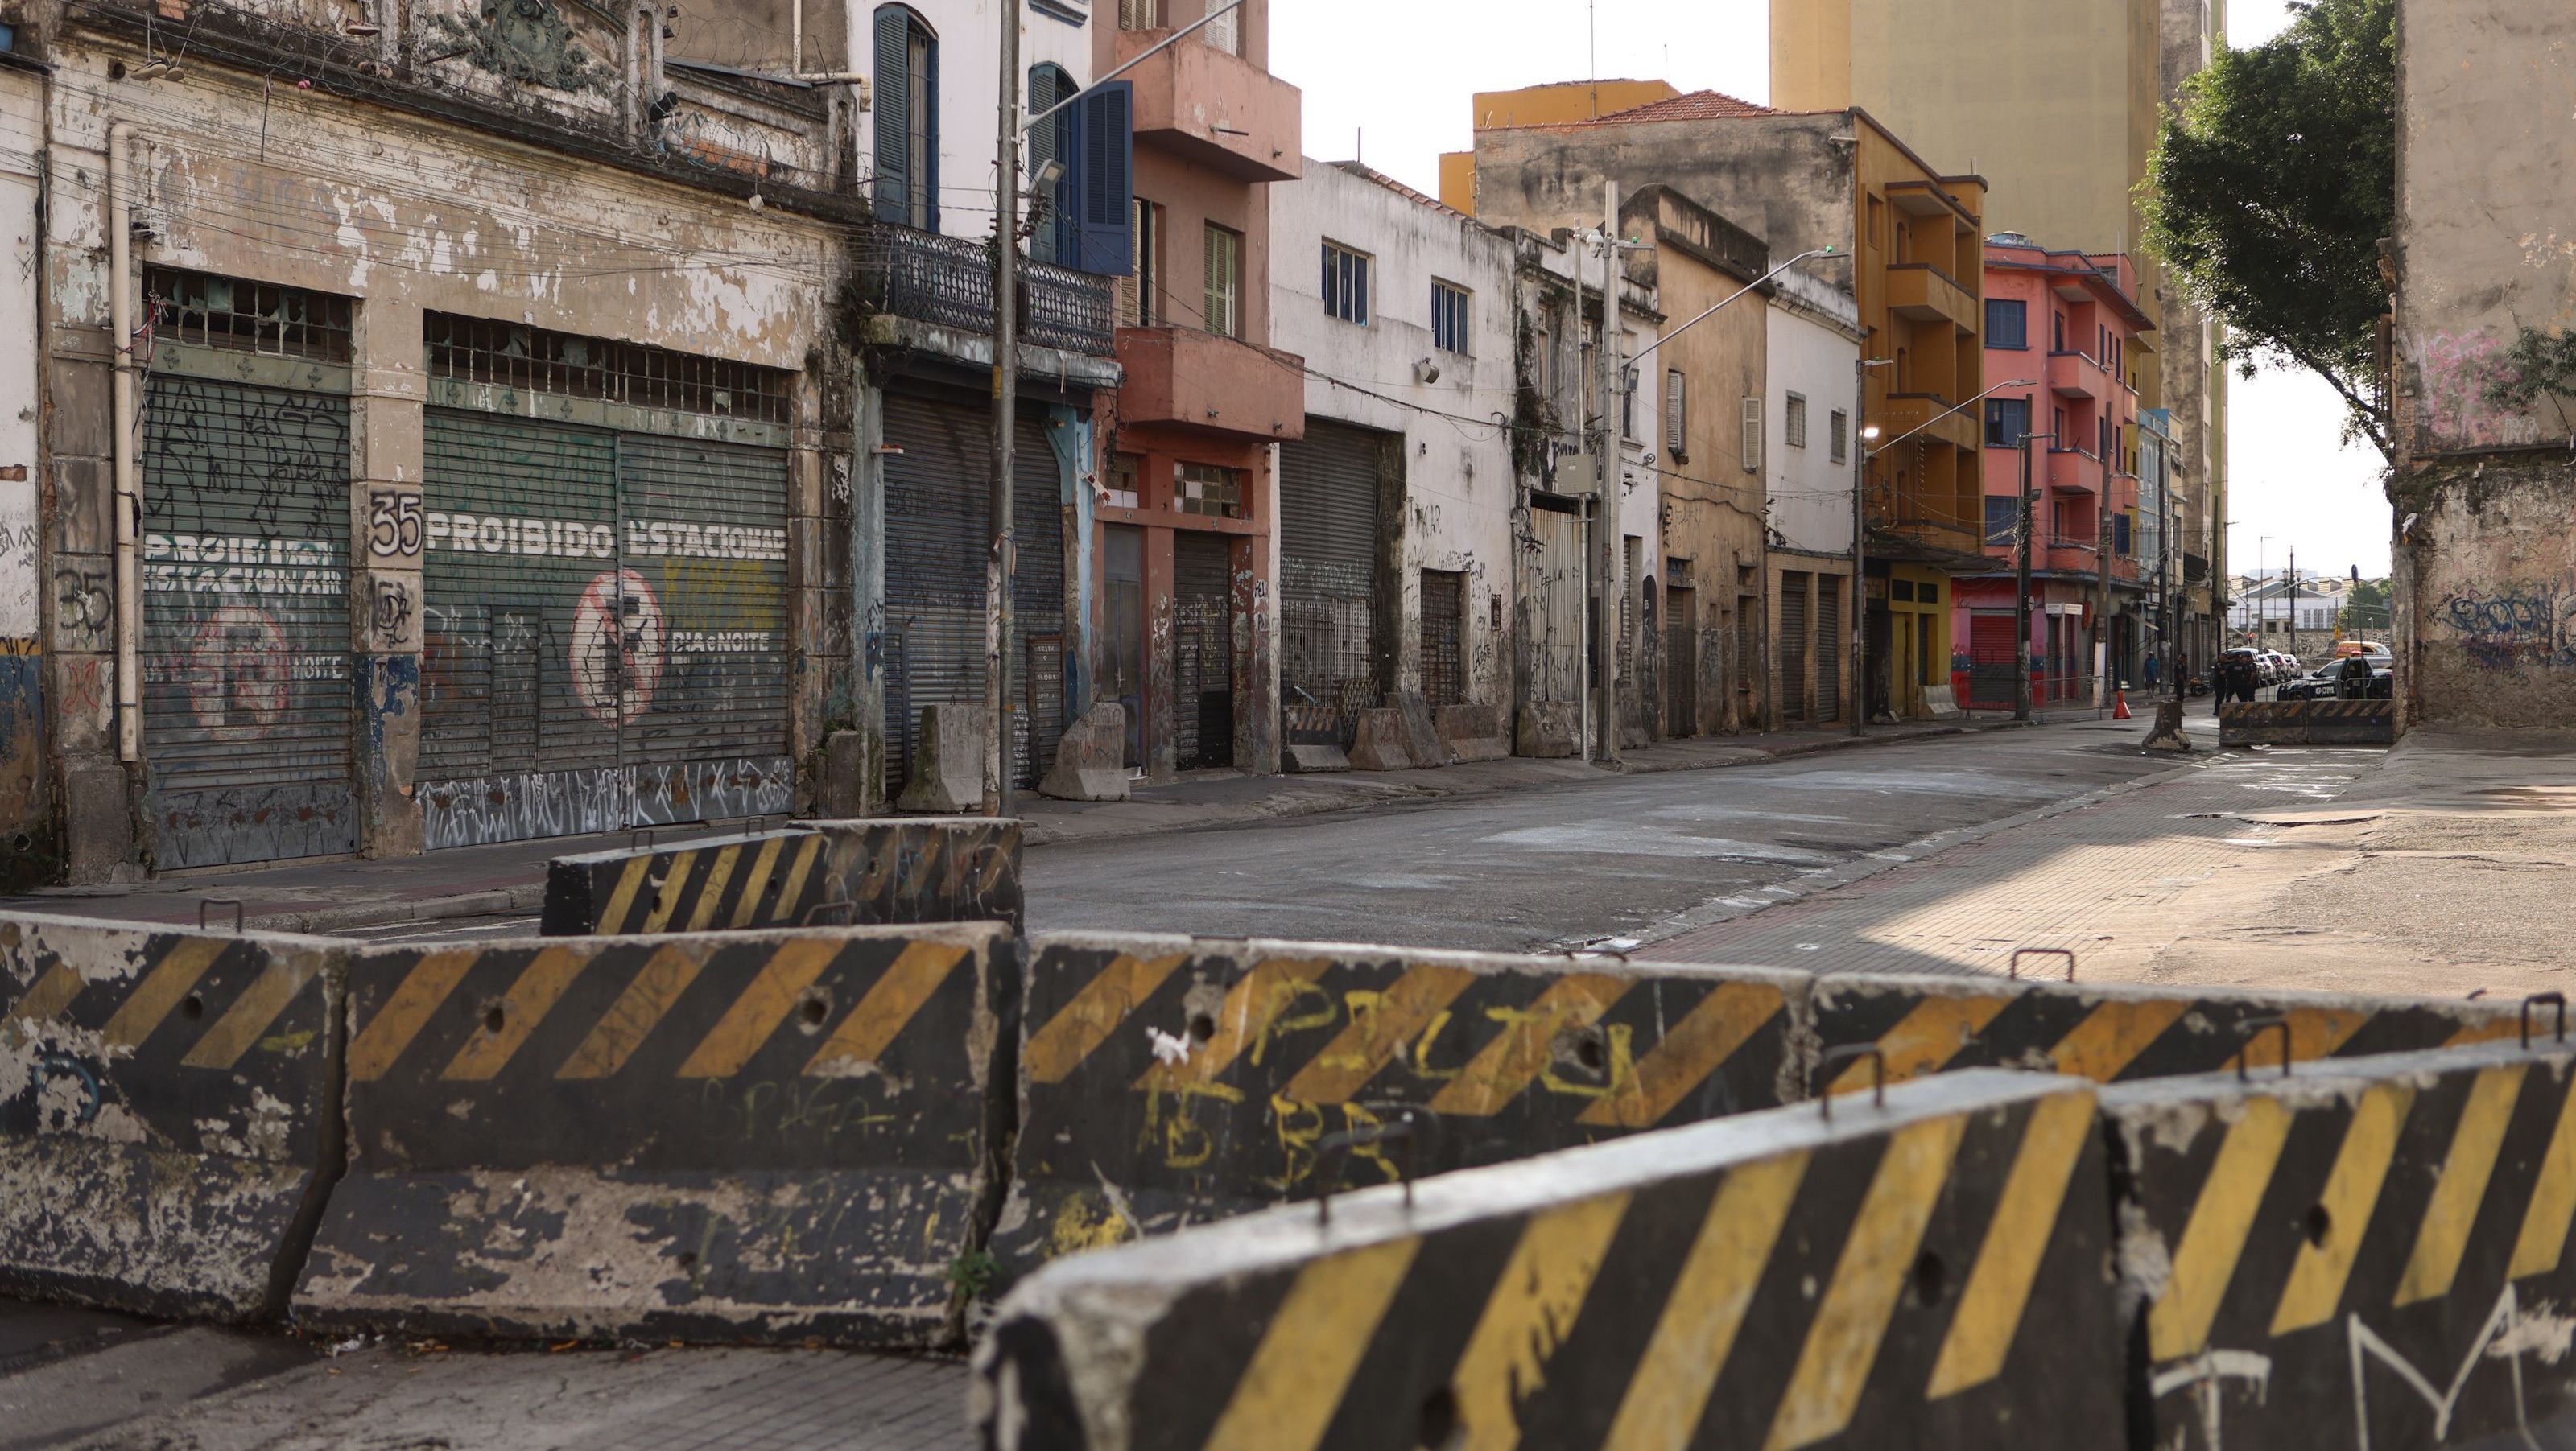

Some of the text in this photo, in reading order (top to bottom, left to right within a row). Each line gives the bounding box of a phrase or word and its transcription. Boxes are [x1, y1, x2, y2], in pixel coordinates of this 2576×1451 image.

[369, 490, 423, 557] 35
[425, 512, 786, 561] PROIBIDO ESTACIONAR
[671, 631, 704, 653] DIA
[716, 632, 770, 653] NOITE
[2315, 686, 2334, 695] GCM
